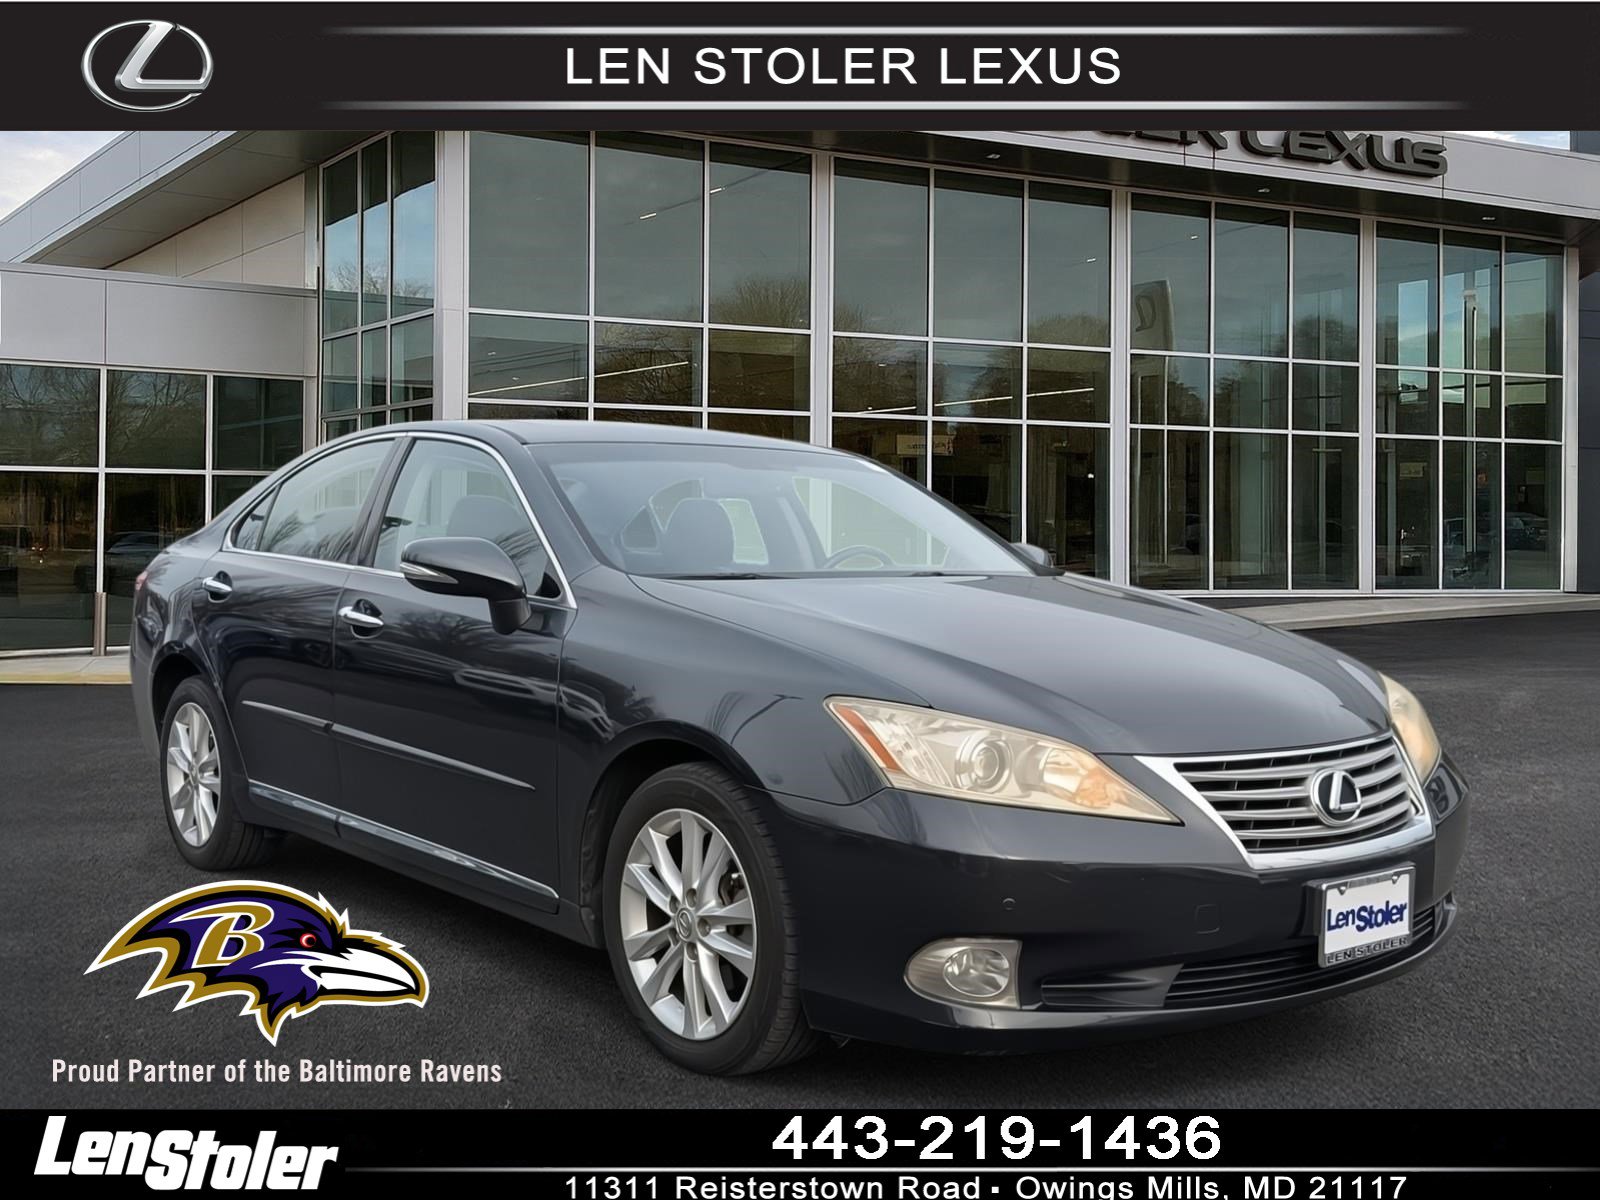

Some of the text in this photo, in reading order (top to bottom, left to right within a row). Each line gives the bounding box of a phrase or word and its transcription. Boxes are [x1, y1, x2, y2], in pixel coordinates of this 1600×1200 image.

[1240, 130, 1449, 178] LEXUS
[1326, 937, 1409, 964] LEN STOLER
